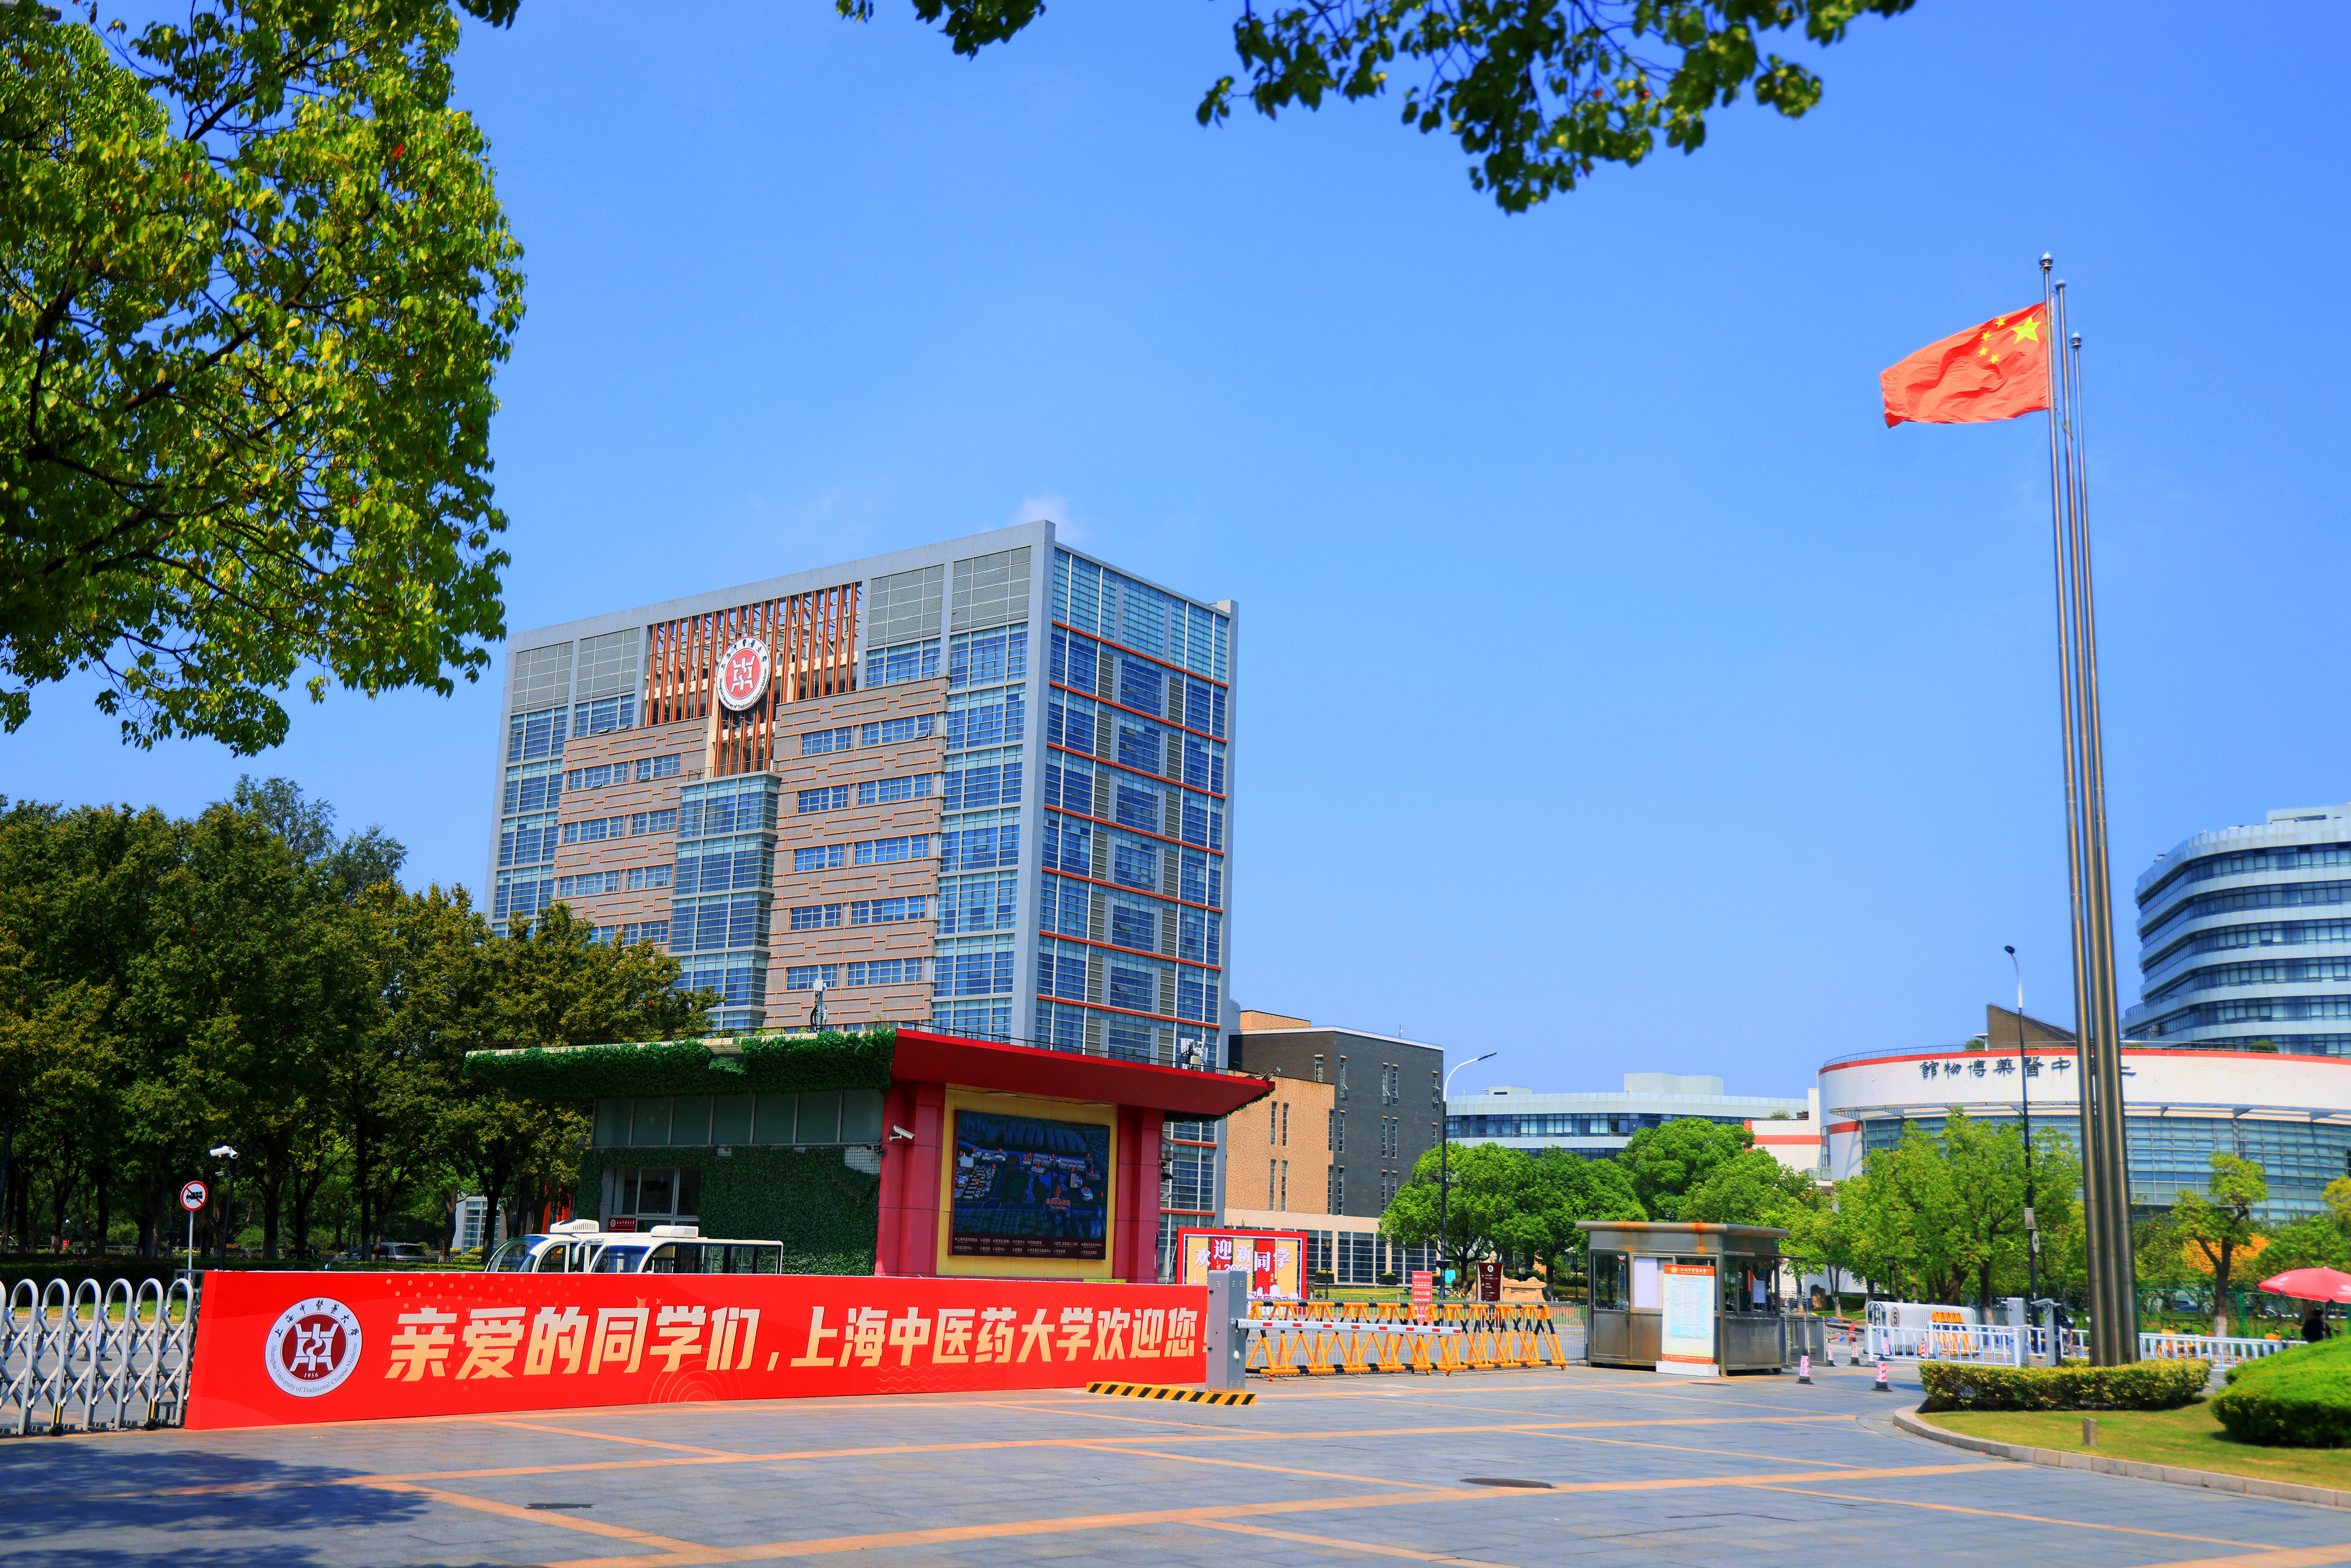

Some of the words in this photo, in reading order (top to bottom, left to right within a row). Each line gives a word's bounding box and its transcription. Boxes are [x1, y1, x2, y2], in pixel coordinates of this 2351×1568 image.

[722, 693, 734, 708] University
[737, 700, 754, 709] Traditional
[753, 689, 763, 701] Chinese
[1920, 1056, 2137, 1080] 中醫藥博物館
[1194, 1239, 1291, 1272] 欢迎新同学
[1893, 1312, 1897, 1324] 5
[269, 1345, 278, 1371] Shanghai
[275, 1367, 296, 1390] University
[302, 1382, 331, 1393] Traditional
[331, 1368, 348, 1385] Chinese
[346, 1342, 358, 1368] Medicine
